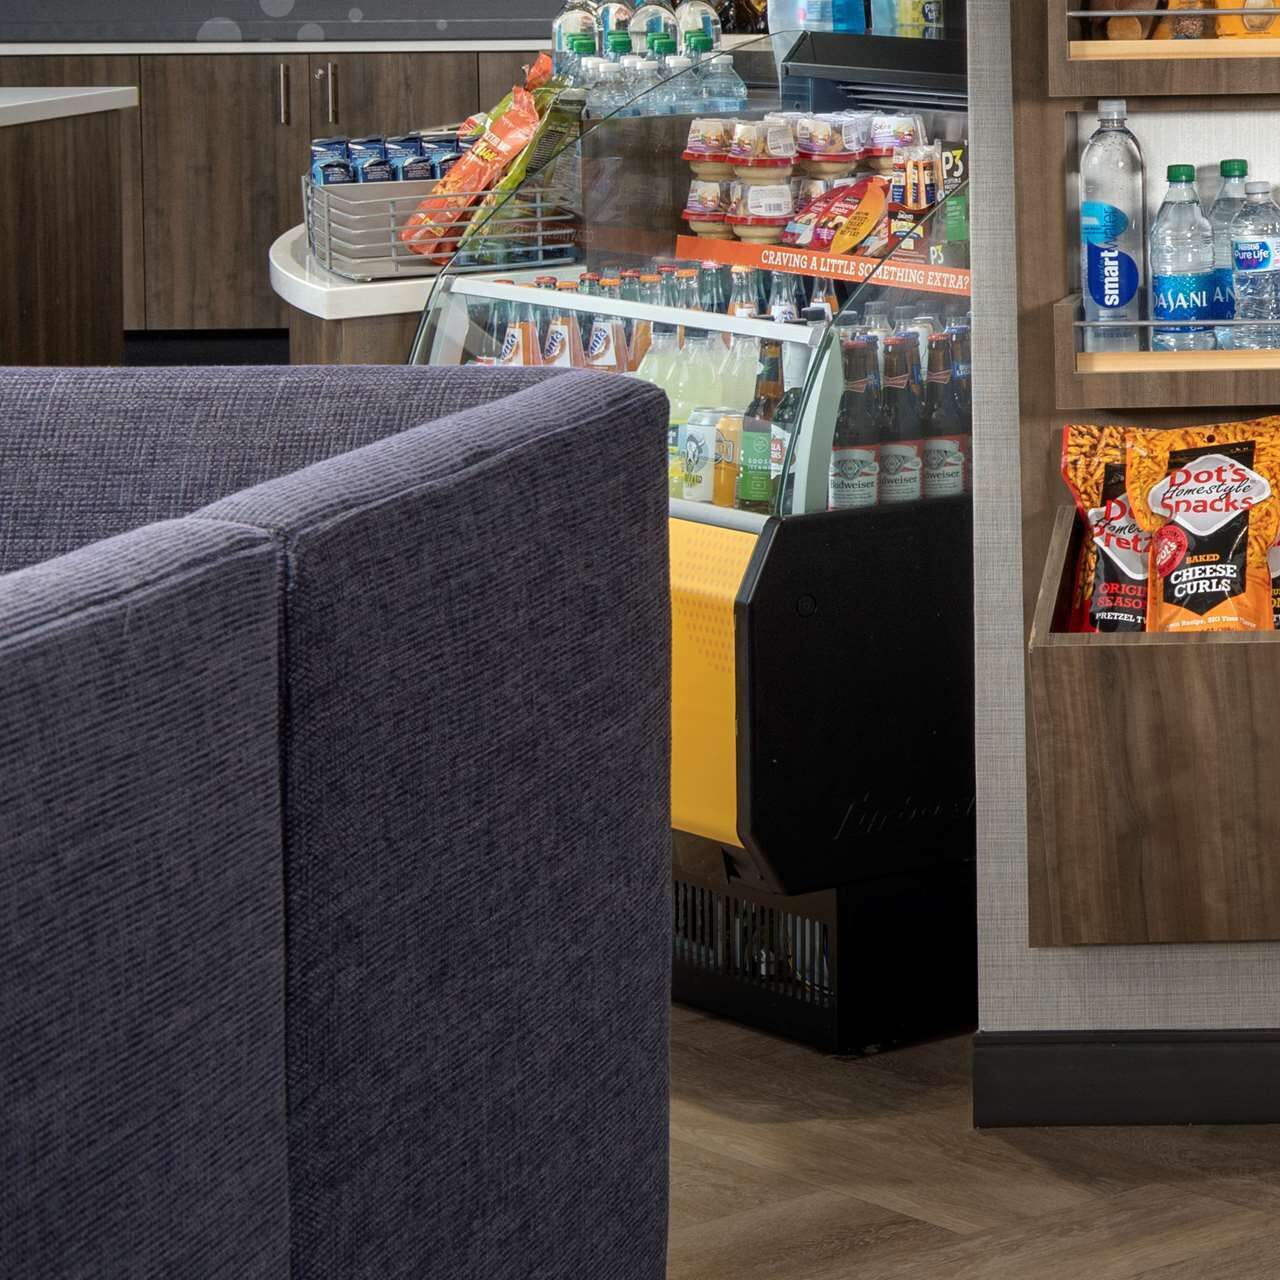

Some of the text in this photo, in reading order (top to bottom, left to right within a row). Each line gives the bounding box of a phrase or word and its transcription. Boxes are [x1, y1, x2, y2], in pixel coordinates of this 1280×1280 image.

[942, 149, 964, 179] P3
[929, 244, 944, 265] P3
[1253, 247, 1271, 263] Life
[761, 250, 970, 290] CRAVING A LITTLE SOMETHING EXTRA?
[1104, 249, 1119, 307] smart
[1169, 463, 1248, 487] Dot's
[1163, 480, 1252, 501] Homestyle
[1160, 496, 1255, 519] Snacks
[1185, 553, 1221, 564] BAKED
[1170, 564, 1238, 586] CHEESE
[1173, 578, 1232, 598] CURLS
[1095, 611, 1135, 624] PRETZEL
